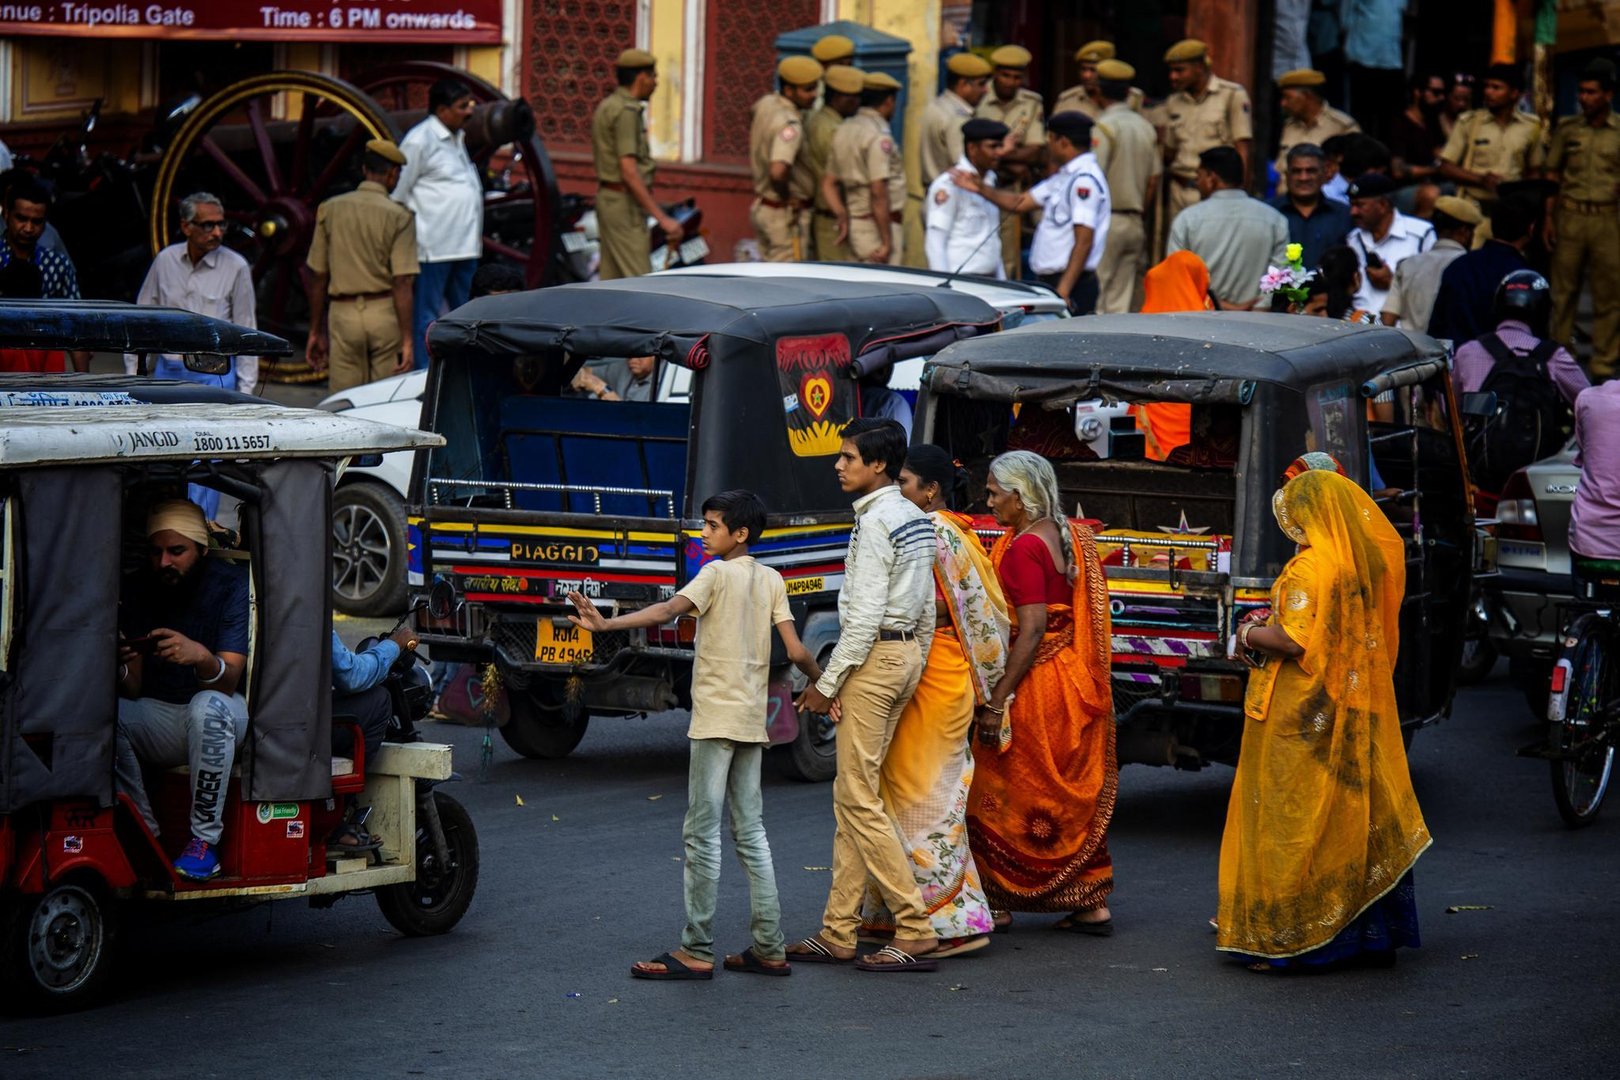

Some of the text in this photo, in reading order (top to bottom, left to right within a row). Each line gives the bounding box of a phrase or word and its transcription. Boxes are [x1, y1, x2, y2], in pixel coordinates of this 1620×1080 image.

[0, 4, 42, 21] nue
[61, 3, 140, 27] Tripolia
[146, 6, 195, 25] Gate
[260, 7, 311, 27] Time
[329, 8, 342, 28] 6
[348, 8, 381, 28] PM
[386, 10, 476, 29] onwards
[194, 435, 270, 451] 1800 11 5657
[511, 543, 599, 562] PIAGGIO
[786, 578, 823, 594] J14PB4946
[552, 627, 579, 643] RJ14
[540, 646, 556, 661] PB
[195, 769, 223, 822] UNDER
